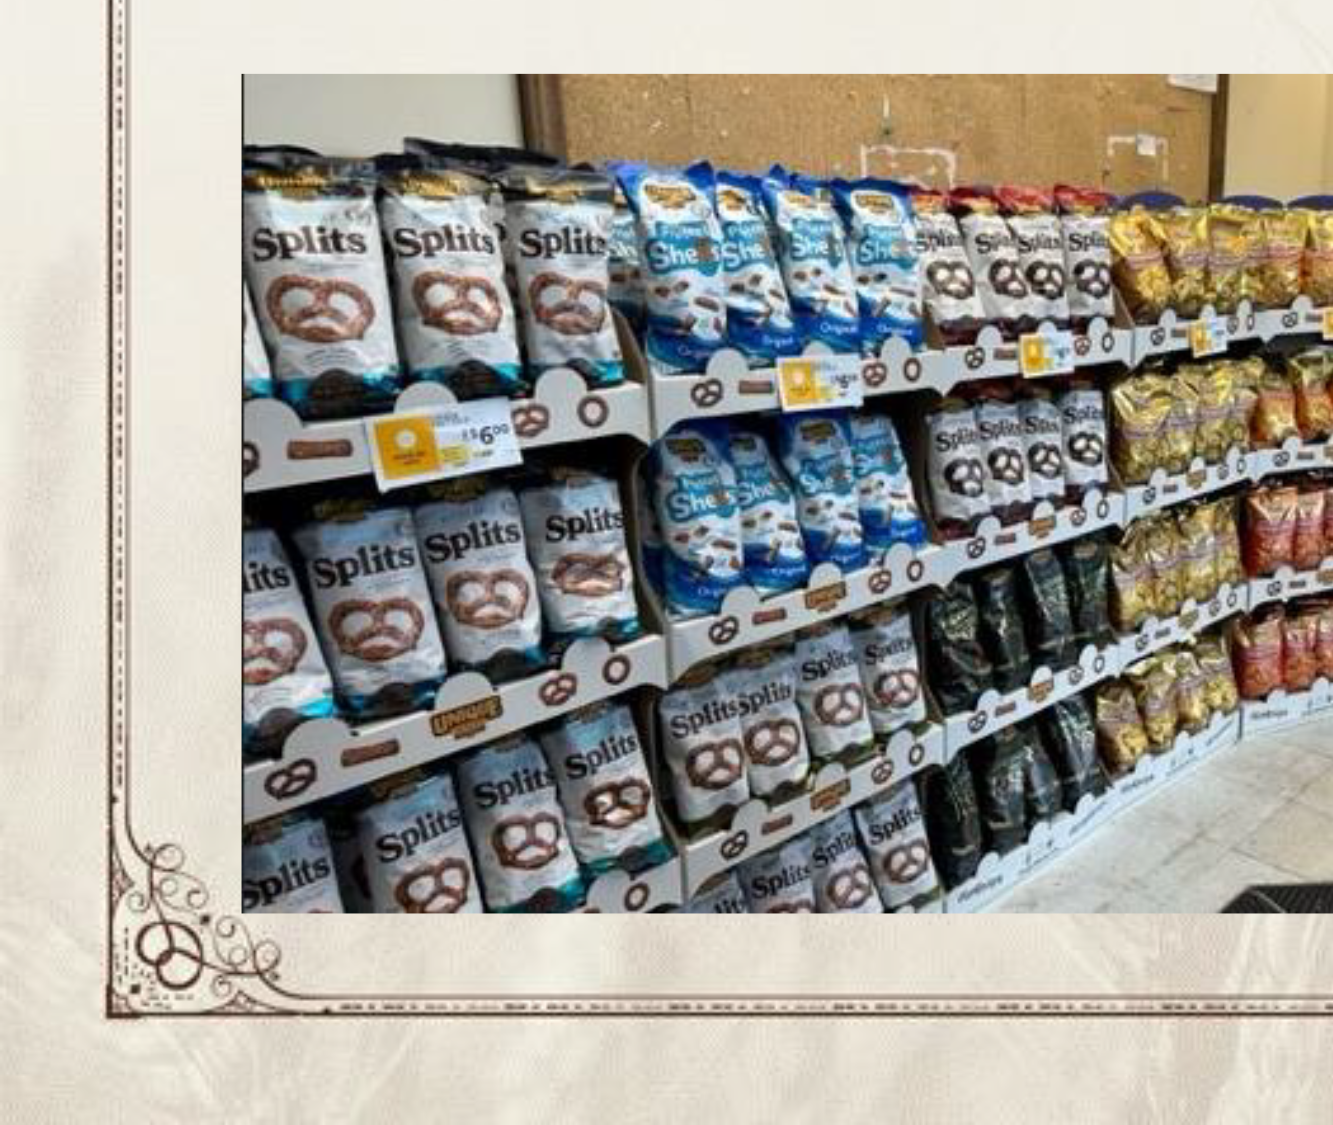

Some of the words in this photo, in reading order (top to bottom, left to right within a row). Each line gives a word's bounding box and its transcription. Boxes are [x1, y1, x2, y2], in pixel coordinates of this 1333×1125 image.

[253, 225, 368, 262] Splits
[394, 223, 496, 260] Splits
[520, 225, 606, 260] Splits
[424, 519, 522, 565] Splits
[544, 507, 624, 544] Splits
[313, 543, 415, 590] Splits
[432, 697, 503, 735] UNIQUE
[670, 698, 740, 739] Splits
[564, 730, 639, 781] Splits
[473, 765, 556, 810] Splits
[375, 804, 461, 863] Splits
[242, 856, 332, 911] Splits
[752, 866, 811, 899] Splits
